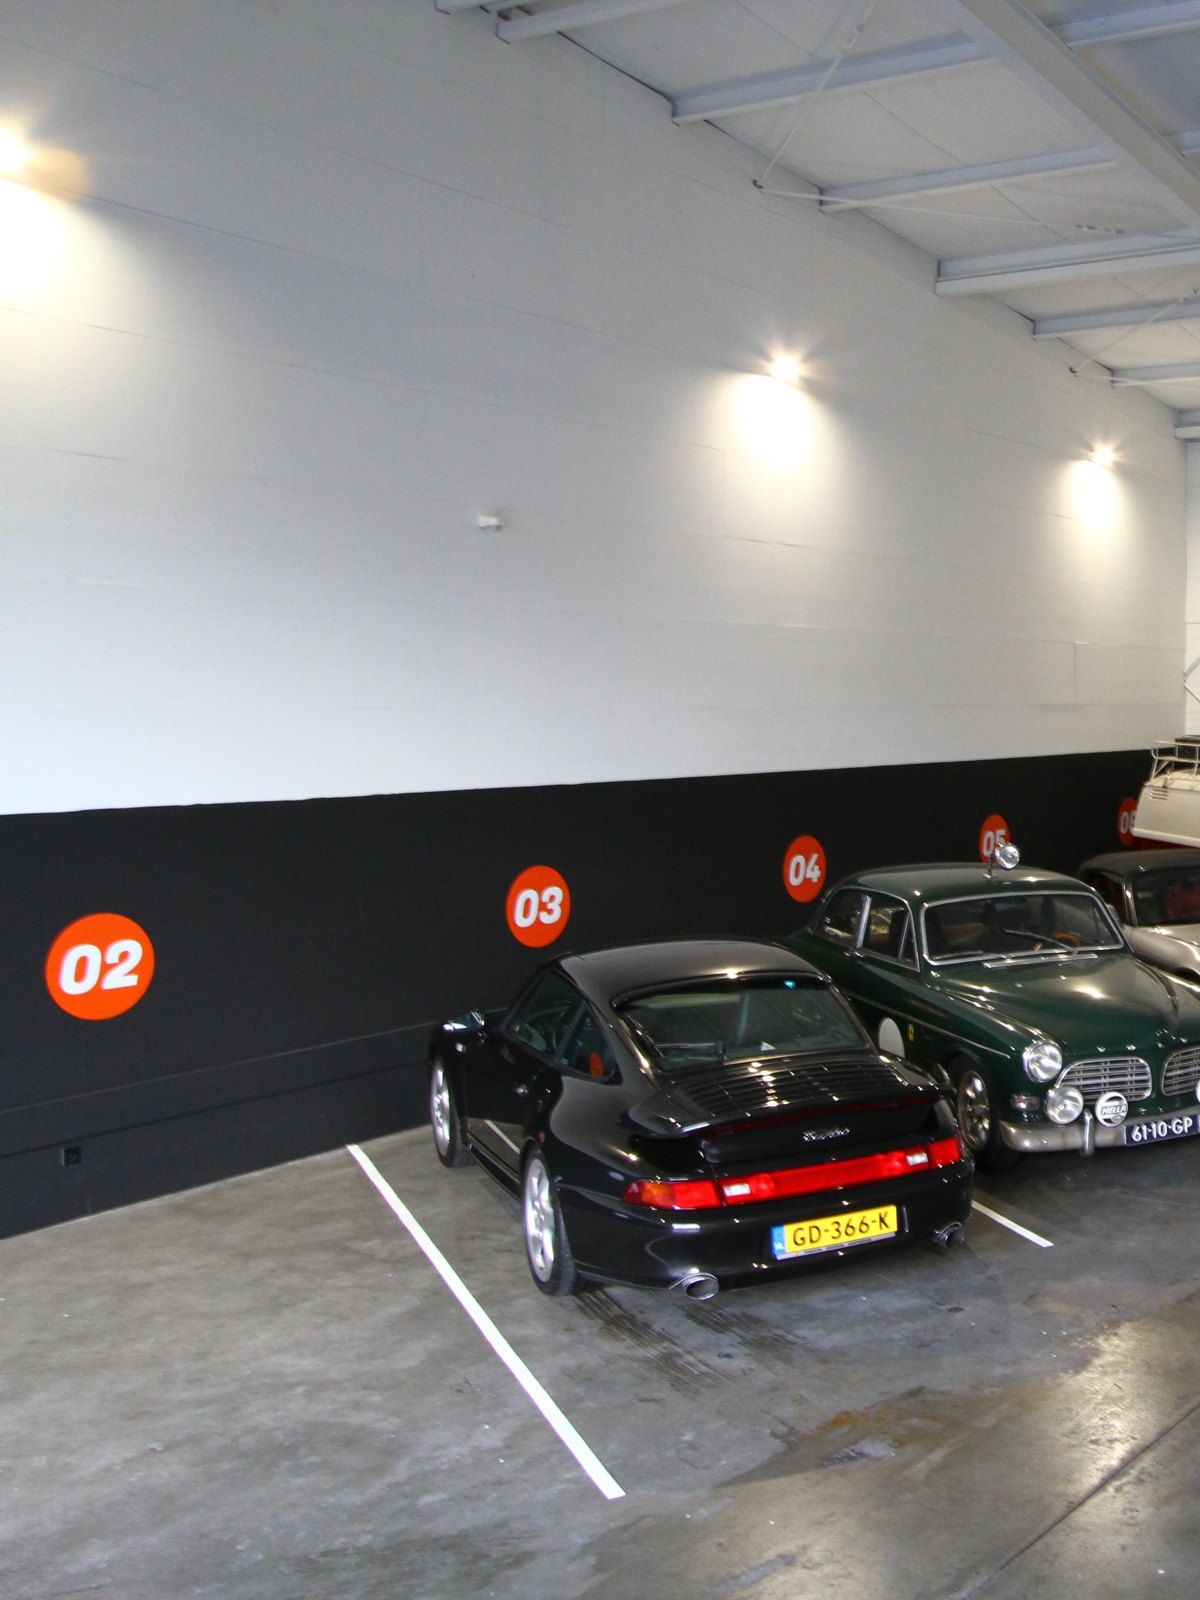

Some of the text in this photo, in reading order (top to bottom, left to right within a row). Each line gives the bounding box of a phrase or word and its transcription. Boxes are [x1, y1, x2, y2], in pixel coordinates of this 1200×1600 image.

[788, 853, 821, 886] 04
[514, 886, 563, 928] 03
[59, 939, 143, 995] 02
[1101, 1104, 1128, 1116] HELLA
[1132, 1116, 1194, 1142] 61-10-GP
[793, 1211, 890, 1246] GD-366-K
